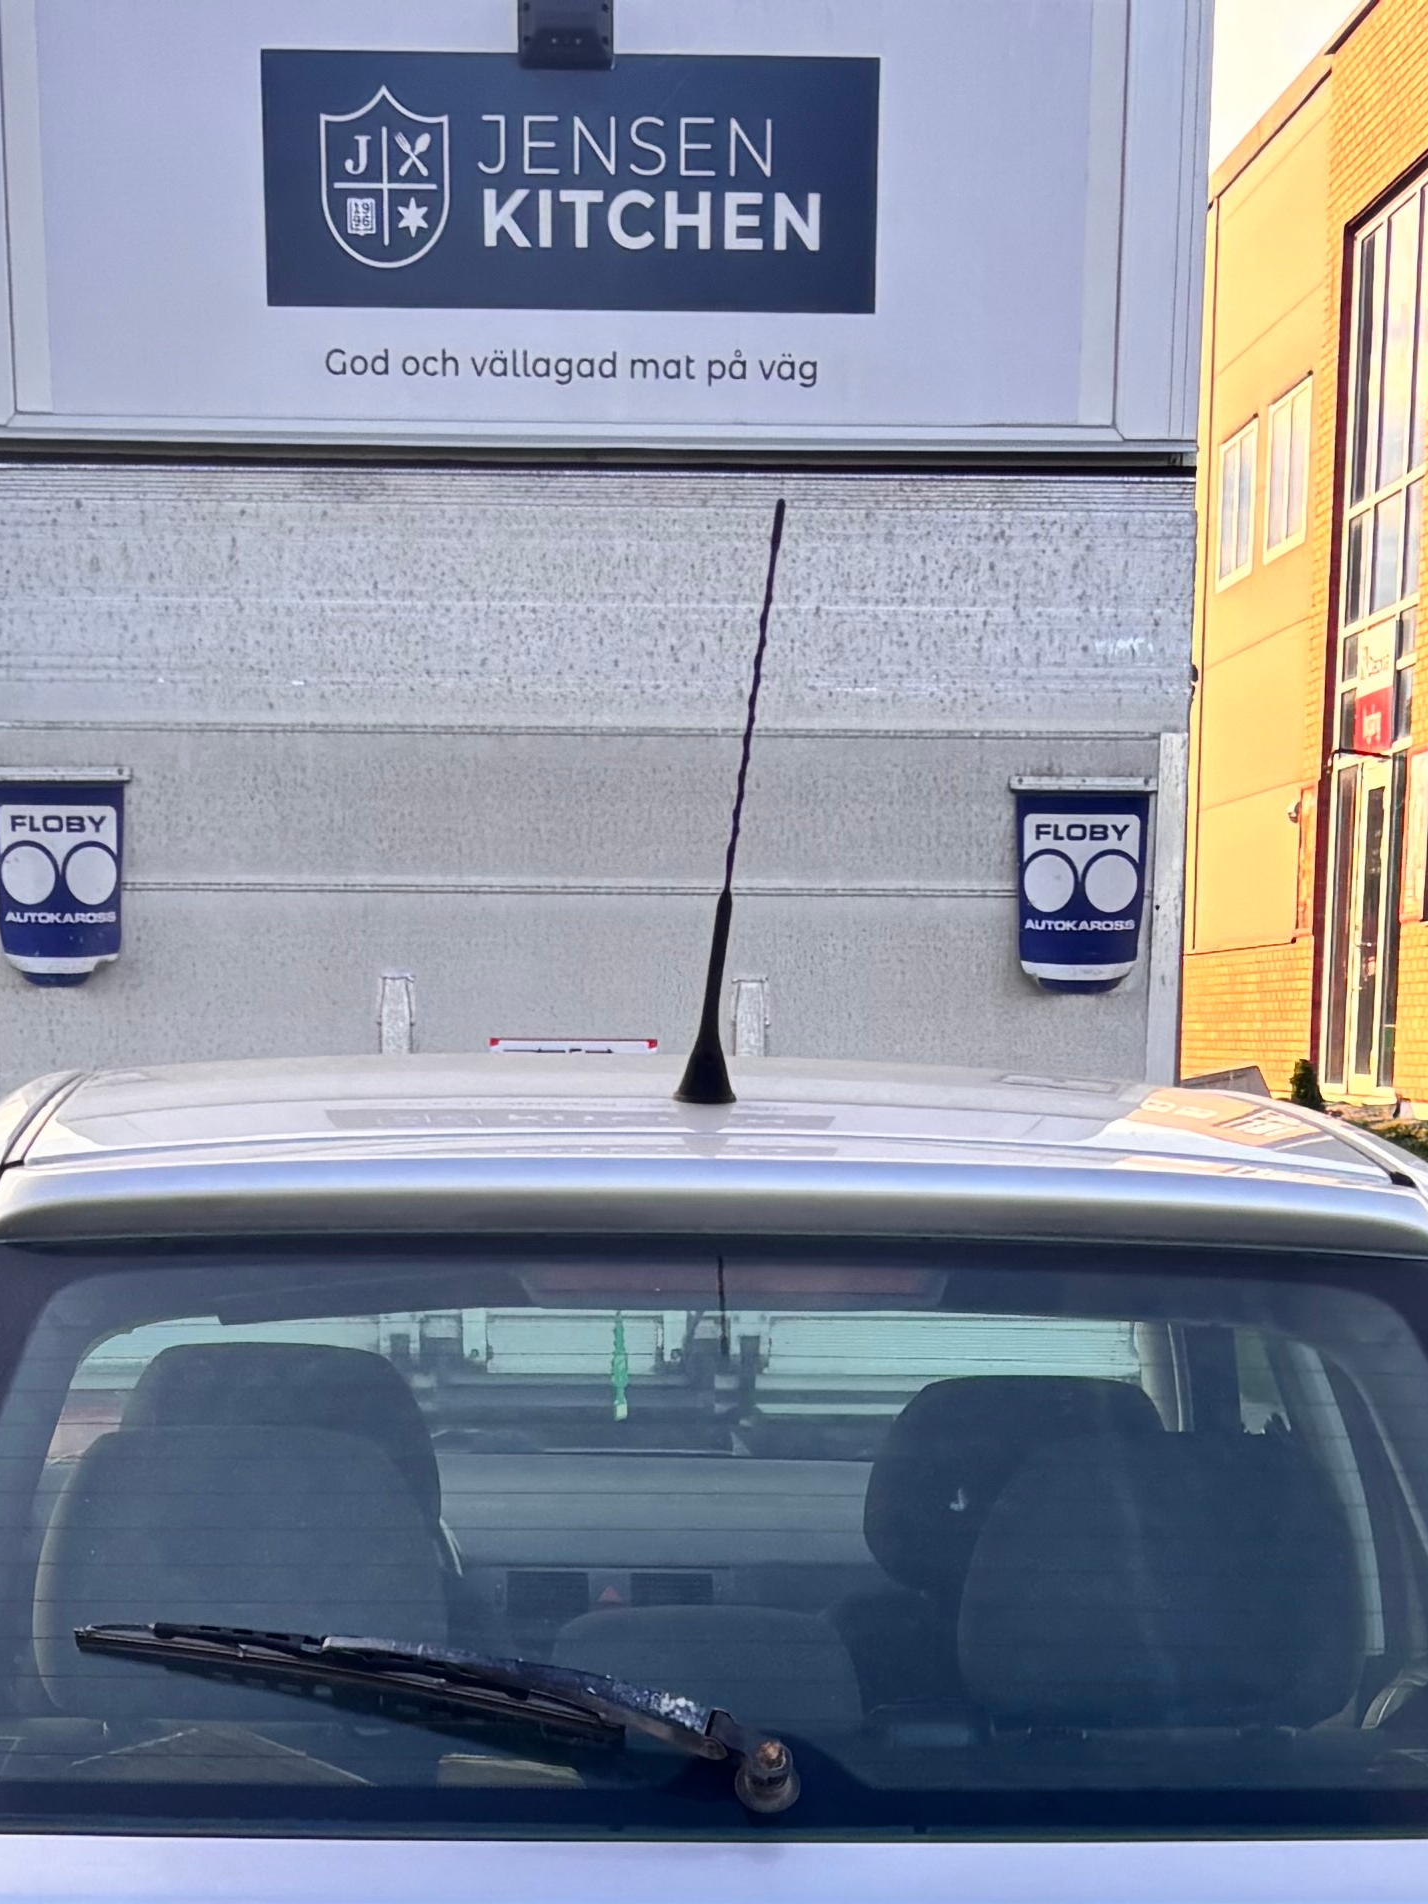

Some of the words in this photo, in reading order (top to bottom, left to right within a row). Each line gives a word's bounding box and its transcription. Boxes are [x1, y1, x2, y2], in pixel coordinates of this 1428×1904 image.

[344, 134, 372, 176] J
[477, 113, 773, 179] JENSEN
[482, 188, 822, 252] KITCHEN
[324, 348, 390, 377] God
[401, 349, 460, 378] och
[471, 349, 618, 386] vällagad
[629, 354, 697, 382] mat
[707, 347, 749, 388] på
[758, 352, 819, 389] väg
[10, 814, 107, 833] FLOBY
[1034, 823, 1131, 842] FLOBY
[4, 910, 117, 924] AUTOKAROSS
[1024, 918, 1136, 932] AUTOKAROSS
